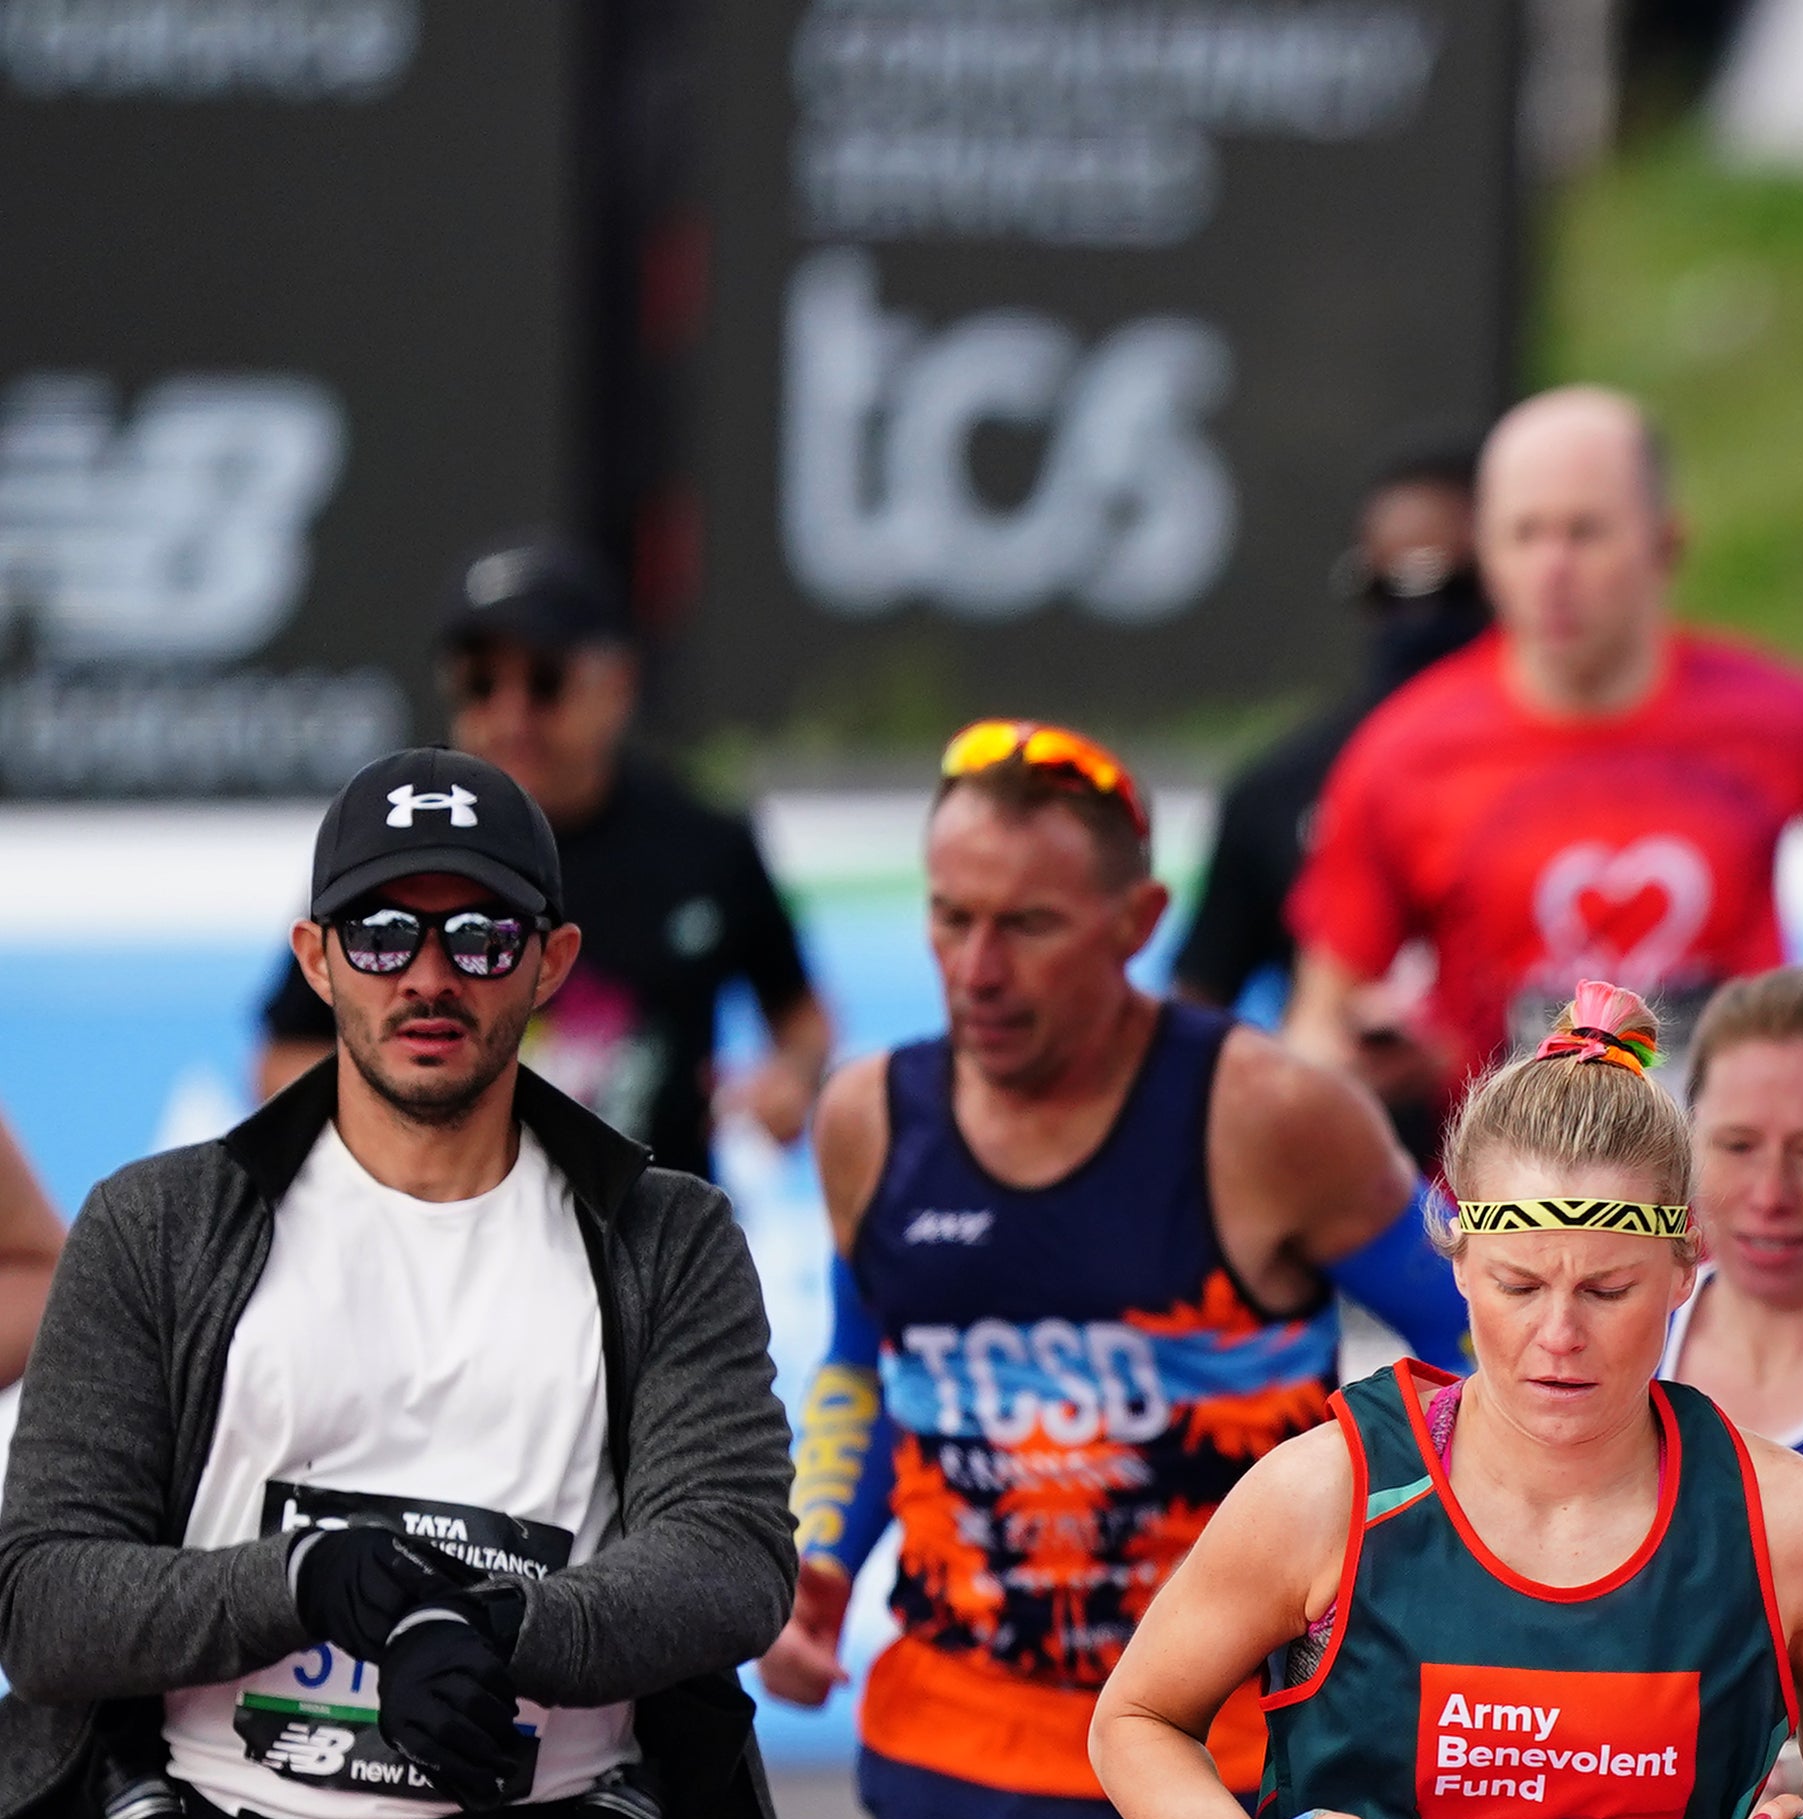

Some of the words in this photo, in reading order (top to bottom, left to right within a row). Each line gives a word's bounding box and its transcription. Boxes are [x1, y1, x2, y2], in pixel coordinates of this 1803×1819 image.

[783, 252, 1236, 620] tcs
[904, 1318, 1172, 1444] TCSD
[402, 1511, 468, 1542] TATA
[1438, 1693, 1560, 1741] Army
[350, 1758, 404, 1784] new
[1437, 1735, 1678, 1777] Benevolent
[1434, 1774, 1546, 1803] Fund
